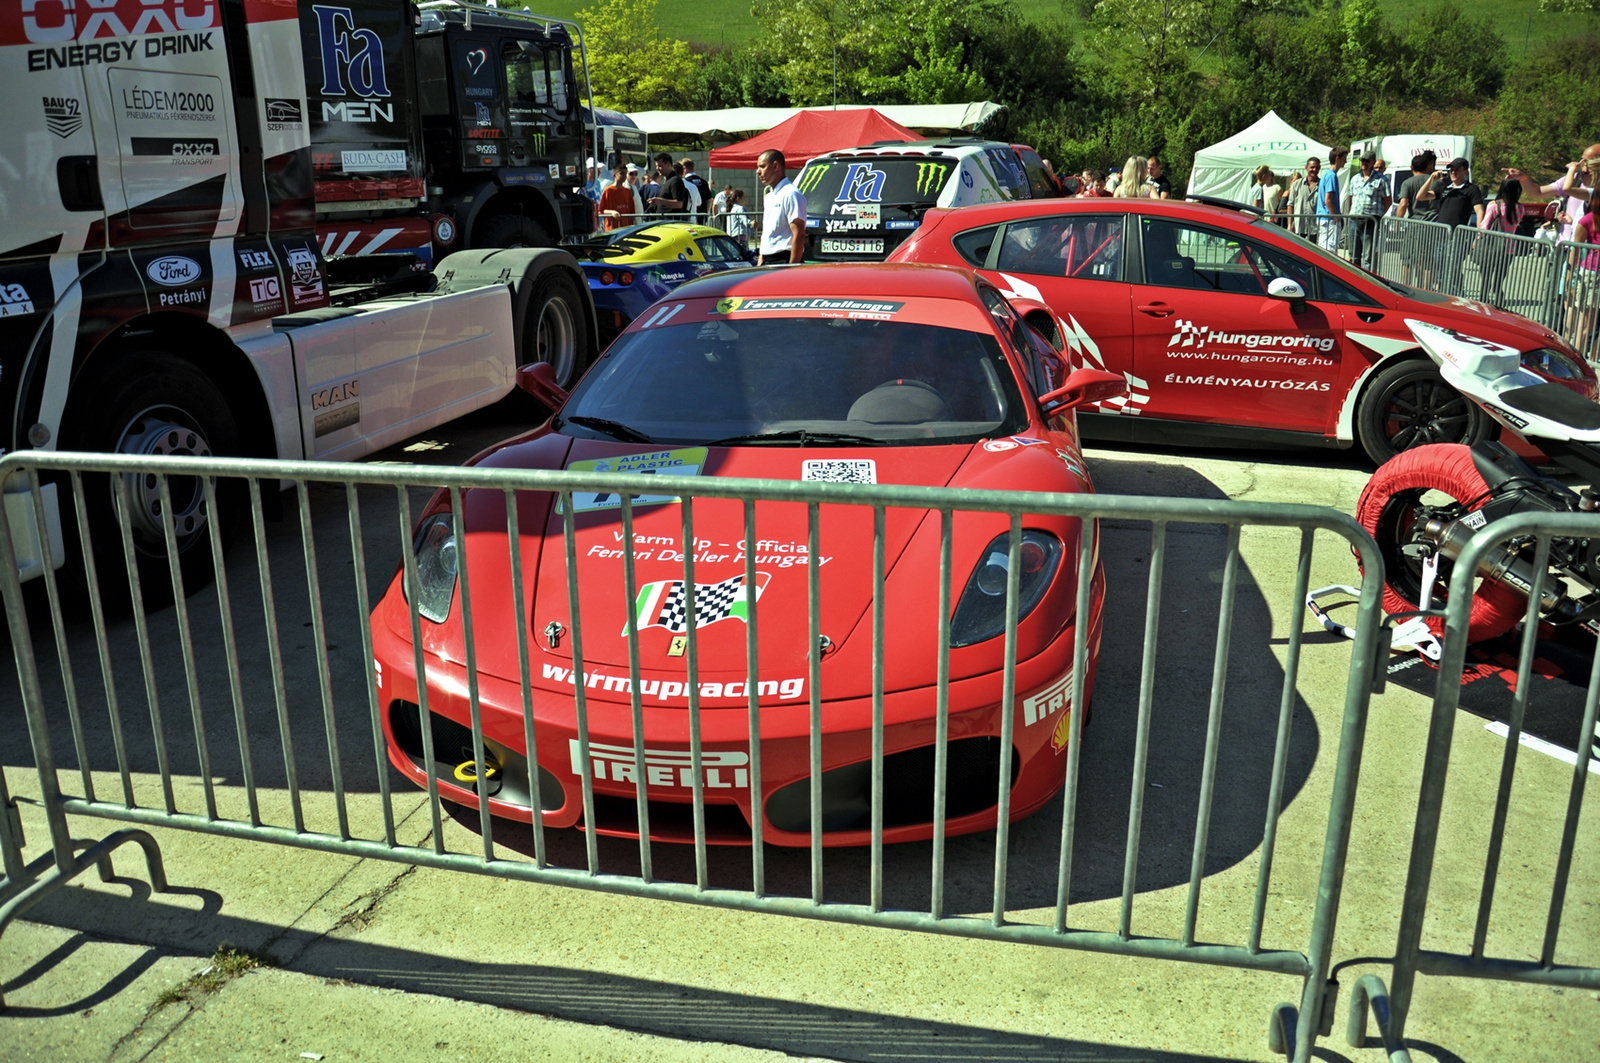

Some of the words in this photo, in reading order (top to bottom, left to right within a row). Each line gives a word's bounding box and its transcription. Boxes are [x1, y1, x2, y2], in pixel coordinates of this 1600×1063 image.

[28, 40, 138, 72] ENERGY
[144, 31, 214, 58] DRINK
[312, 4, 392, 97] Fa
[122, 85, 214, 112] LÉDEM2000
[465, 87, 493, 97] HUNGARY
[42, 97, 65, 108] BAU
[468, 128, 500, 139] LOCTITE
[172, 143, 214, 156] OXXO
[171, 158, 214, 166] TRANSPORT
[342, 152, 405, 166] BUDA-CASH
[834, 162, 887, 203] Fa
[830, 203, 857, 215] ME
[240, 251, 273, 268] FLEX
[158, 260, 192, 280] Ford
[0, 283, 29, 303] ta
[159, 287, 206, 307] Petrányi
[743, 300, 808, 310] Ferrari
[808, 298, 894, 311] Challenge
[1206, 330, 1335, 351] Hungaroring
[1166, 351, 1333, 367] www.hungaroring.hu
[1164, 372, 1331, 391] ÉLMÉNYAUTÓZÁS
[311, 380, 359, 411] MAN
[616, 459, 684, 472] PLASTIC
[619, 452, 671, 464] ADLER
[736, 539, 809, 553] Officia
[733, 551, 833, 568] Hungay
[568, 738, 749, 788] PIRELLI
